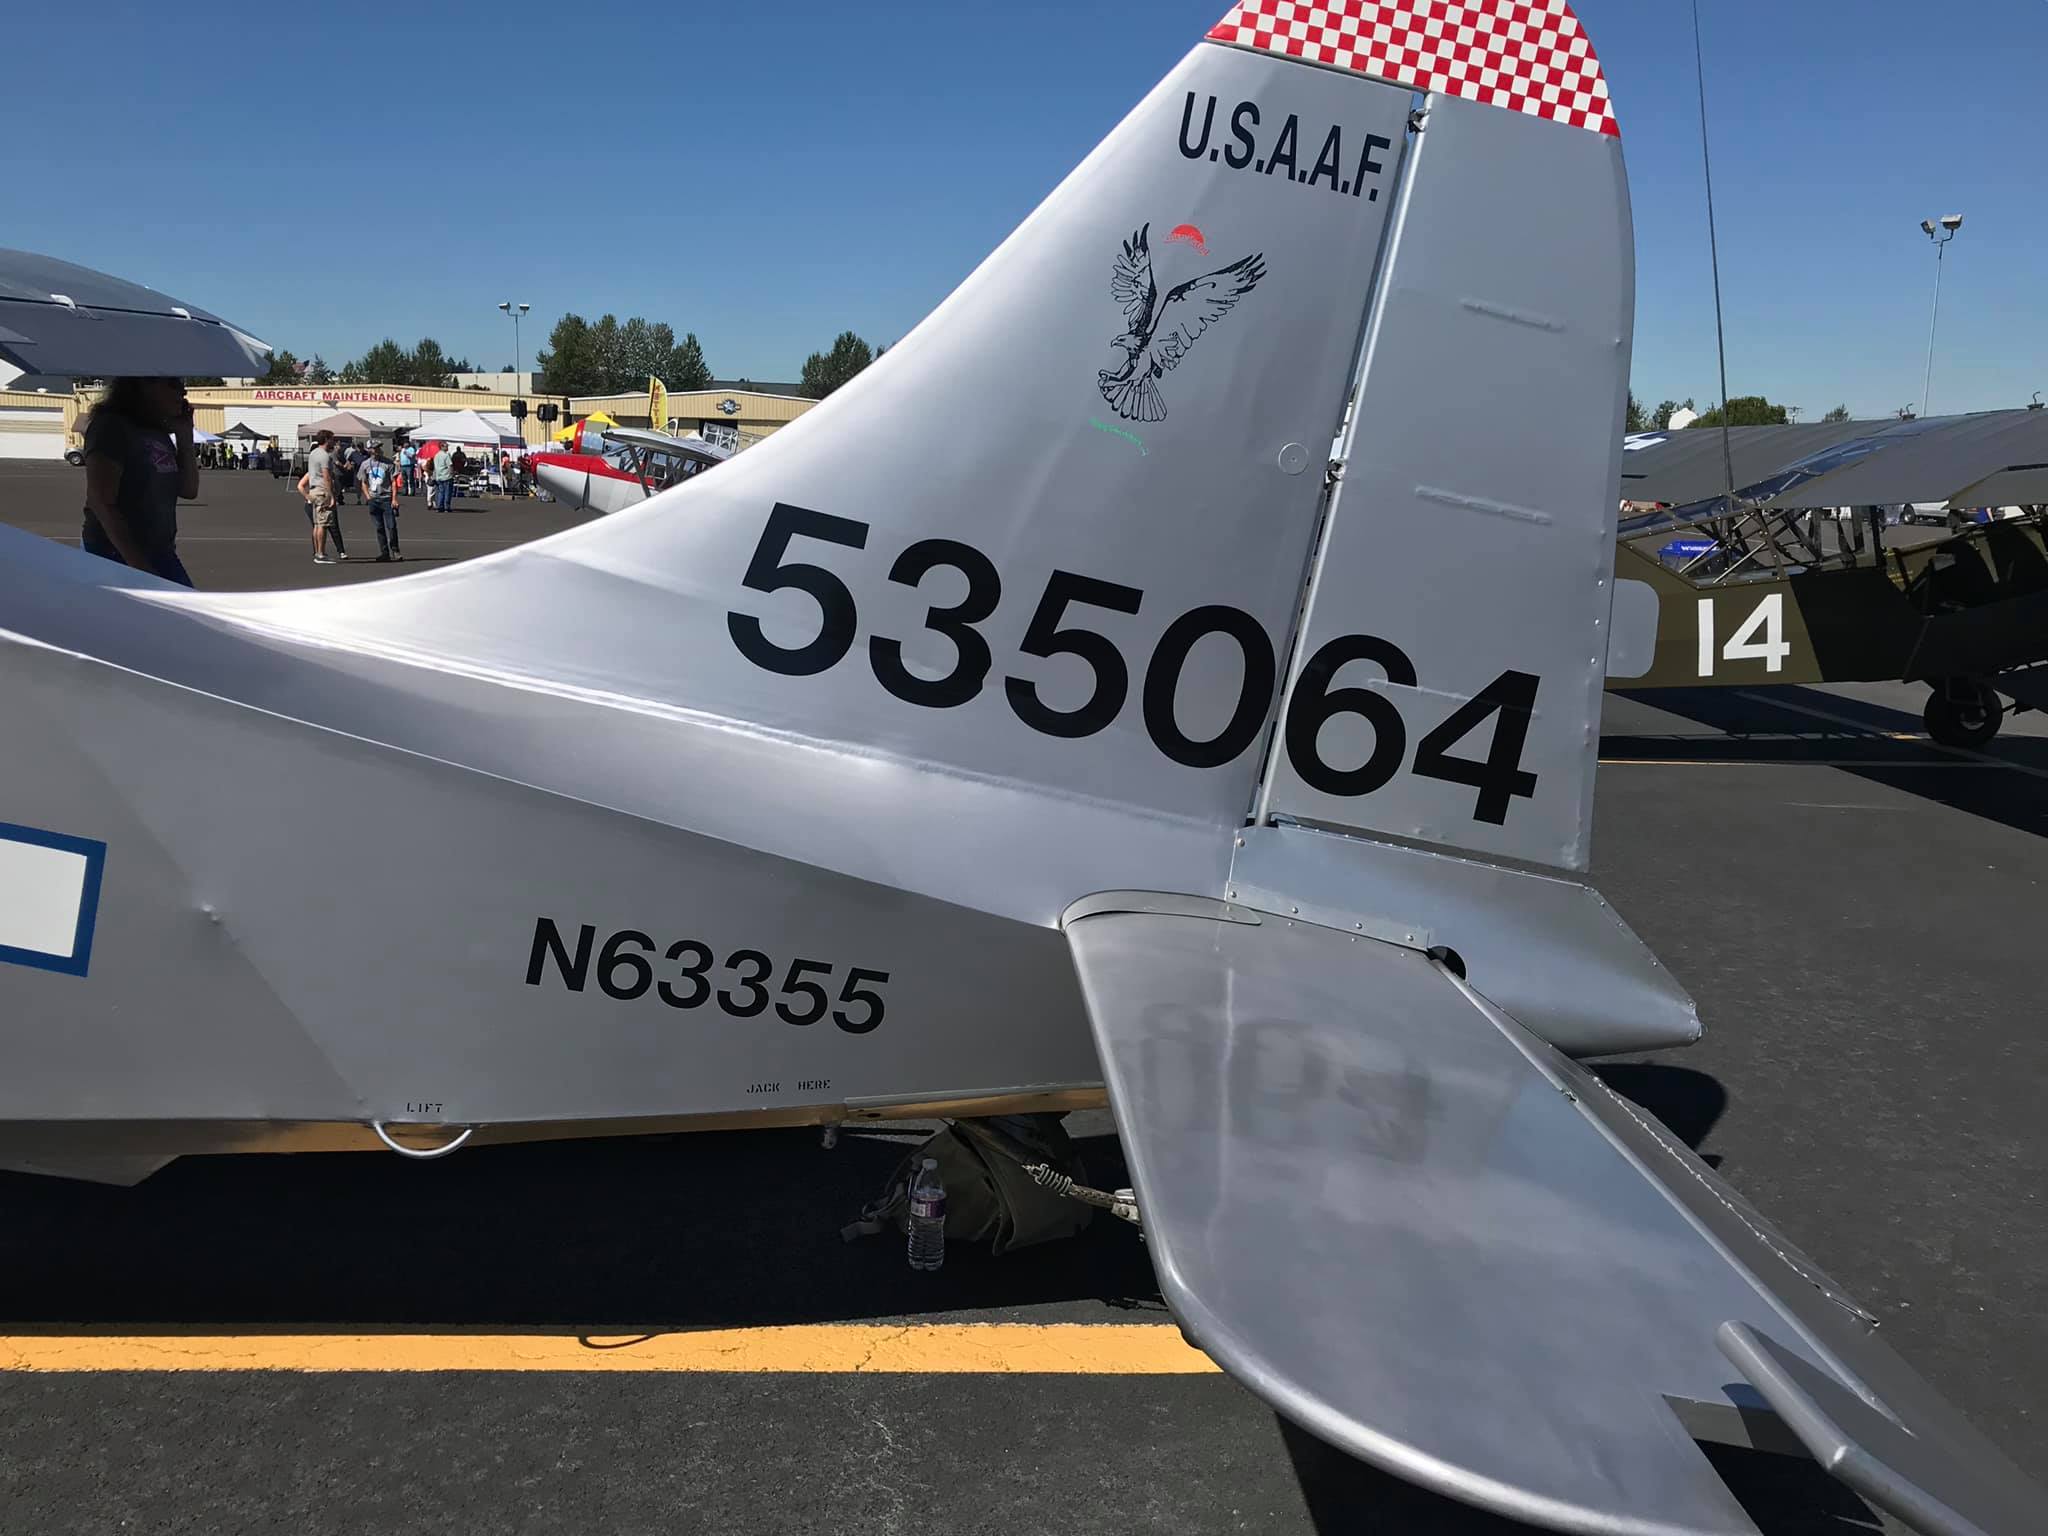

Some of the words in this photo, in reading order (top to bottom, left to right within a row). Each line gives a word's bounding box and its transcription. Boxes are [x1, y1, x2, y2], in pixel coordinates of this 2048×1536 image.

[1178, 91, 1391, 202] U.S.A.A.F.
[255, 391, 317, 400] AIRCRAFT
[322, 391, 412, 403] MAINTENANCE
[727, 502, 1542, 827] 535064
[1697, 593, 1790, 678] 14
[525, 917, 890, 1034] N63355
[407, 1102, 444, 1113] LIFT
[746, 1082, 780, 1093] JACK
[798, 1080, 831, 1090] HERE
